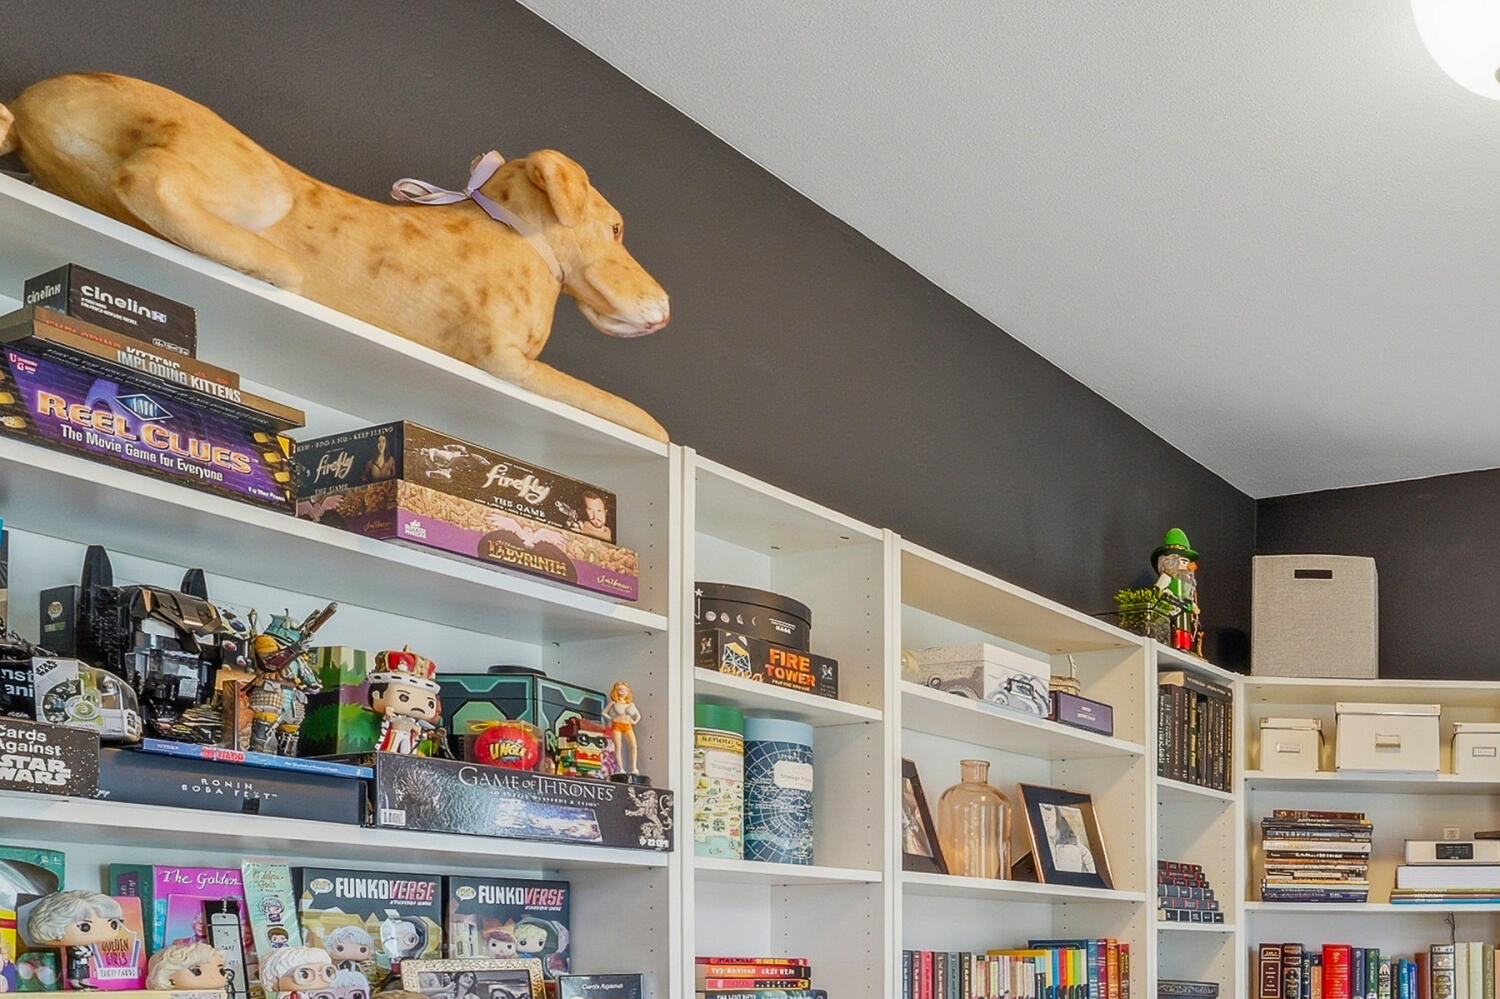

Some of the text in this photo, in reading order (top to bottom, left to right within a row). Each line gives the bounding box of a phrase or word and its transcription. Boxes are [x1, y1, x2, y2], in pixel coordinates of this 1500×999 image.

[117, 350, 188, 384] IMPLODING
[190, 374, 241, 403] KITTENS
[37, 390, 138, 441] REEL
[60, 423, 223, 483] The Movie Game for Everyone
[314, 450, 354, 484] firefly
[482, 463, 551, 504] firefly
[493, 495, 513, 508] THE
[515, 502, 546, 518] GAME
[488, 540, 568, 577] LABYRINTH
[769, 648, 811, 673] FIRE
[764, 664, 816, 687] TOWER
[0, 753, 69, 774] STAR
[201, 778, 253, 791] RONIN
[458, 766, 616, 802] GAME OF THRONES
[160, 869, 243, 890] The Golden
[335, 877, 436, 902] FUNKOVERSE
[478, 885, 565, 907] FUNKOVERSE
[101, 939, 129, 952] GOLDEN
[105, 952, 128, 967] GIRLS
